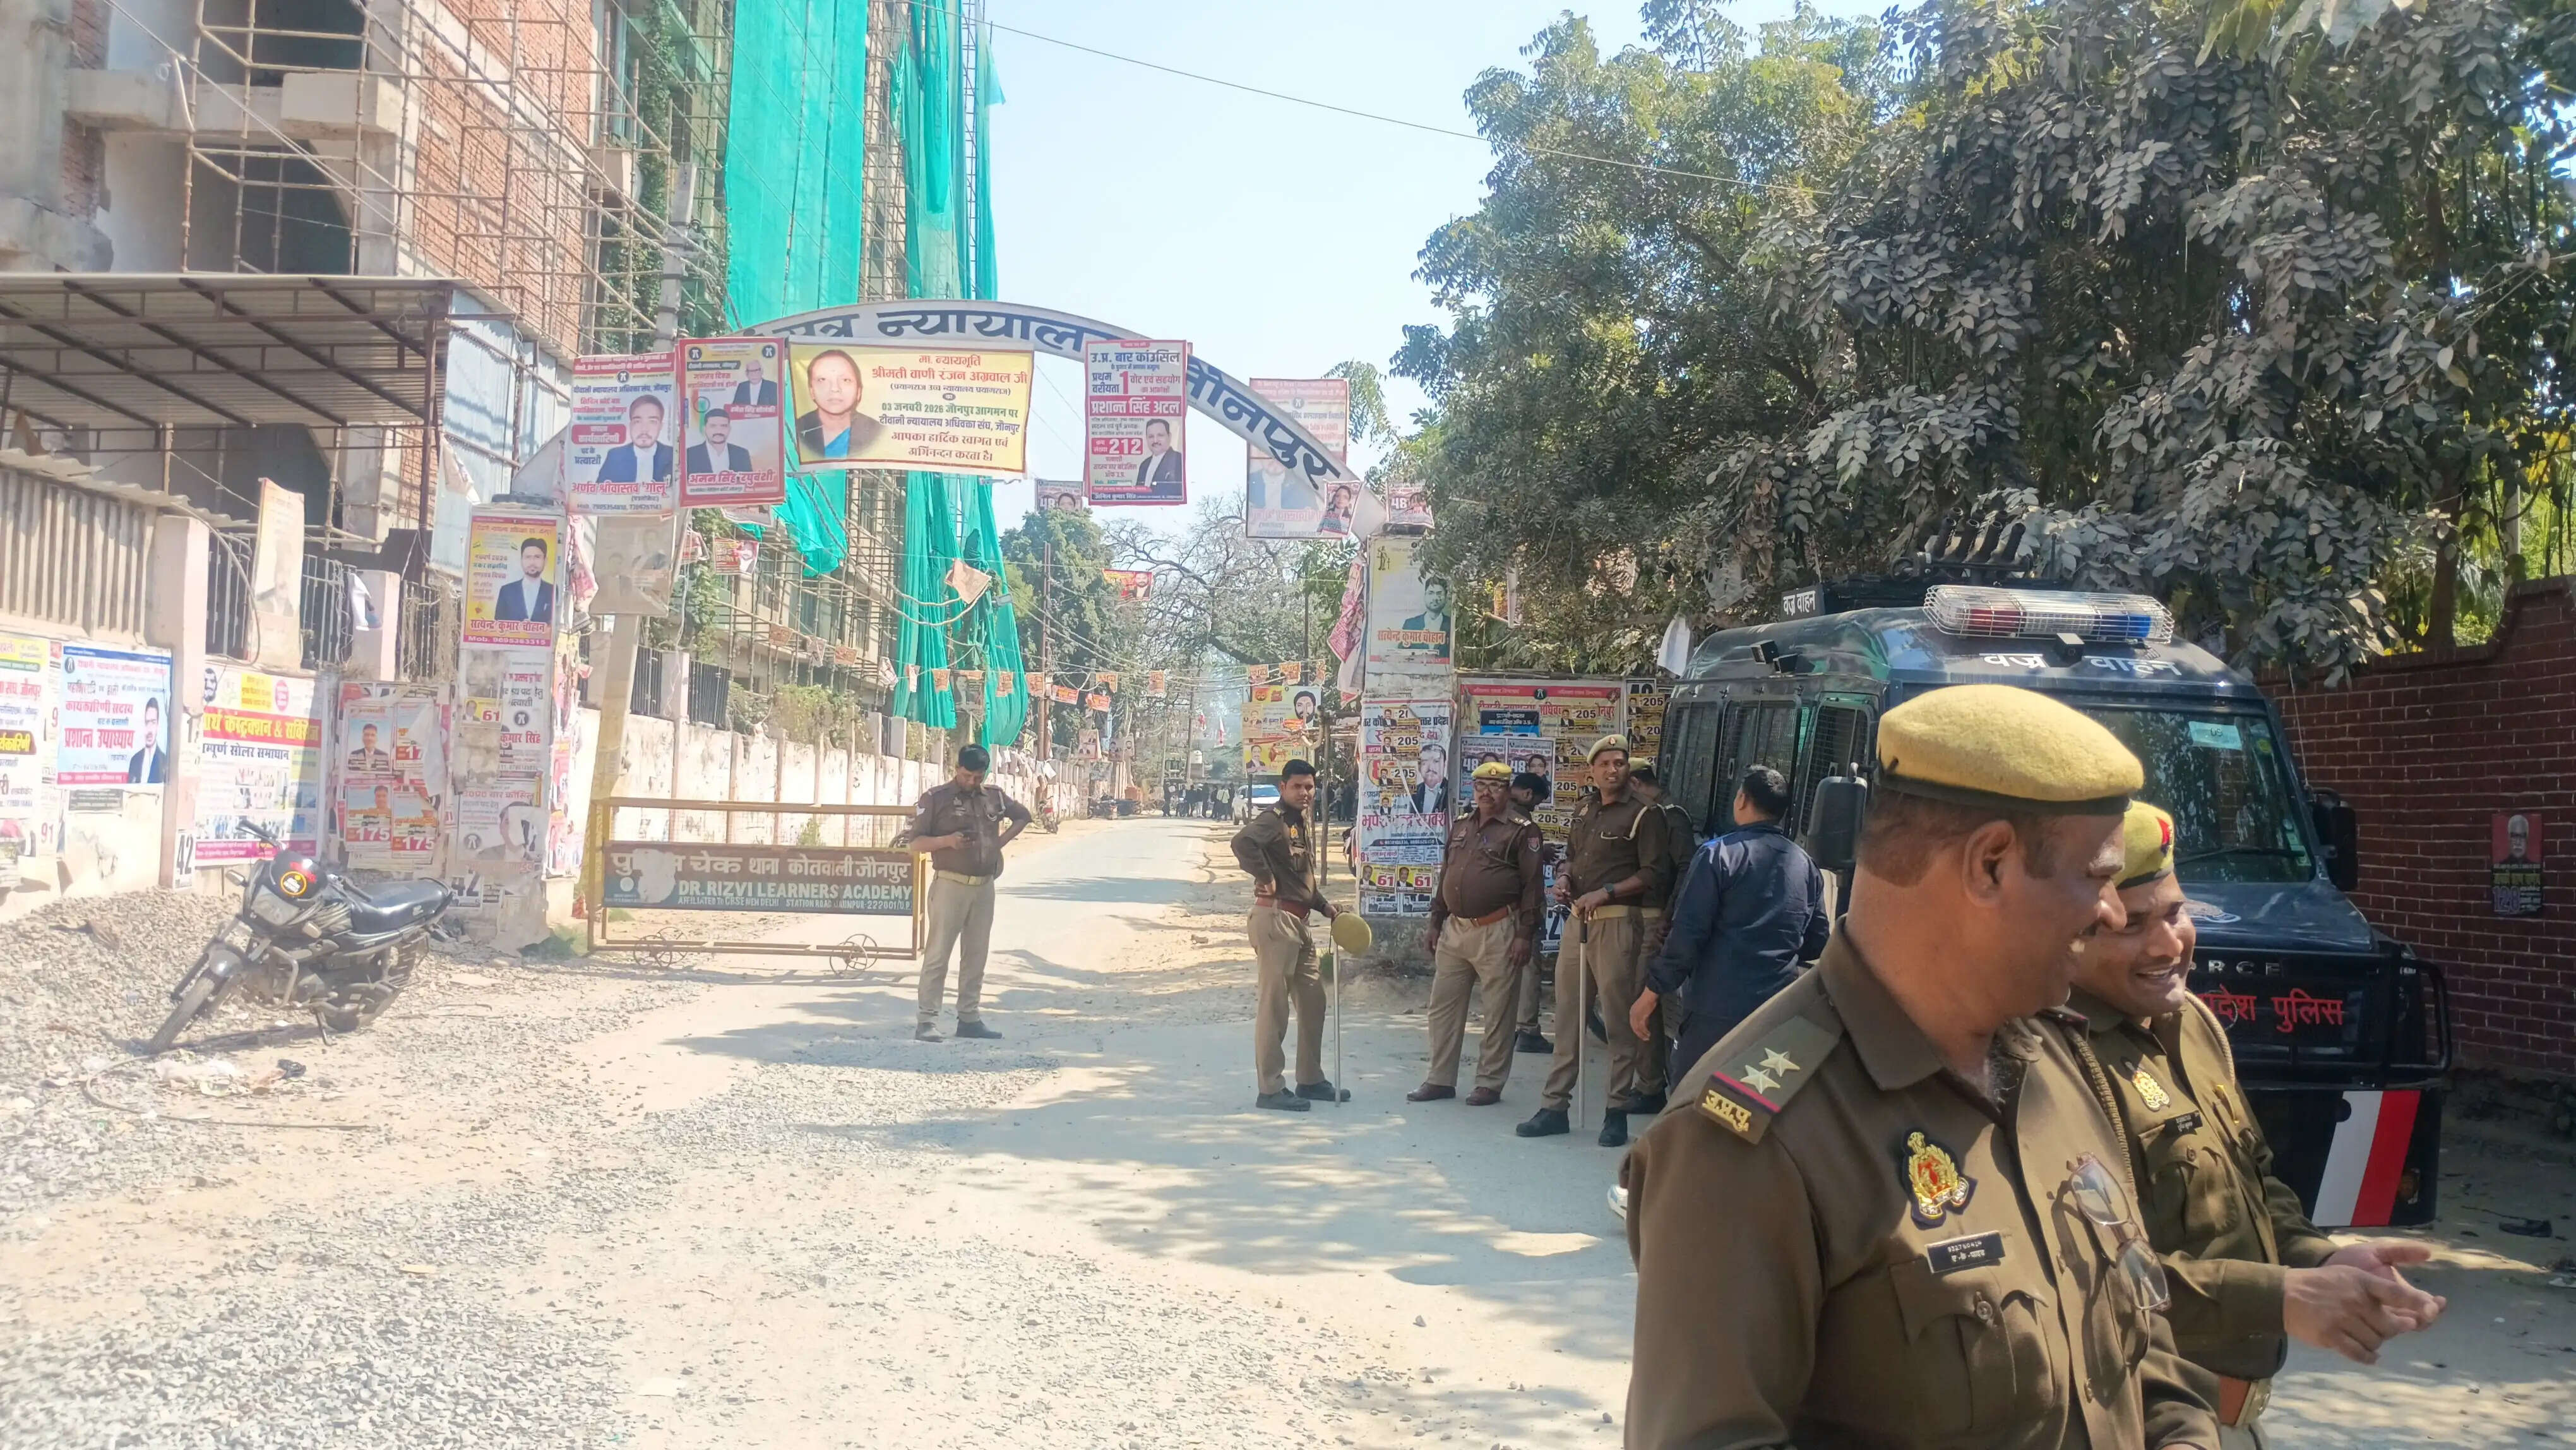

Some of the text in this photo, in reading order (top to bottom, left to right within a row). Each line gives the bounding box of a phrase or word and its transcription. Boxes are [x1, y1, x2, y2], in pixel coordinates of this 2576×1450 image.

[877, 309, 1121, 352] न्यायाल
[1115, 352, 1133, 362] बार
[872, 366, 1028, 384] श्रीमती वाणी रंजन अग्रवाल जी
[1092, 372, 1112, 381] प्रथम
[1119, 371, 1129, 394] 1
[1144, 374, 1154, 384] एवं
[1155, 373, 1181, 384] सहयोग
[1092, 382, 1119, 393] वरीयता
[881, 401, 1018, 418] 03 जनवरी 2026 जौनपुर आगमन पर
[1091, 397, 1181, 414] प्रशान्त सिंह अटल
[879, 414, 1020, 435] दीवानी न्यायालय अधिवक्ता संघ, जौनपुर
[891, 431, 1008, 448] आपका हार्दिक स्वागत एवं
[1109, 438, 1142, 454] 212
[575, 455, 601, 465] प्रत्याशी
[908, 446, 952, 458] अभिनन्दन
[955, 450, 981, 461] करता
[689, 473, 716, 484] अमन
[718, 470, 737, 484] सिंह
[600, 480, 640, 494] श्रीवास्तव
[1783, 589, 1816, 616] वज्र वाहन
[498, 620, 519, 633] कुमार
[523, 620, 546, 632] चौहान
[1402, 631, 1421, 646] कुमार
[1422, 629, 1445, 644] चौहान
[1979, 652, 2183, 676] वज्र वाहन
[112, 702, 134, 715] सदस्य
[1643, 697, 1664, 706] 205
[482, 710, 500, 722] 61
[1575, 710, 1596, 719] 205
[274, 720, 283, 738] &
[97, 728, 135, 749] उपाध्याय
[501, 730, 541, 748] कुमार सिंह
[1398, 736, 1419, 745] 205
[202, 741, 290, 760] म्पूर्ण सोलर समाधान
[1462, 758, 1479, 771] 48
[1510, 760, 1526, 773] 48
[1557, 782, 1577, 791] 205
[1537, 813, 1558, 824] 205
[356, 827, 391, 841] 175
[403, 836, 436, 850] 175
[177, 834, 194, 875] 42
[689, 850, 743, 873] चेक
[749, 857, 780, 875] थाना
[787, 853, 854, 877] कोतवाली
[855, 855, 912, 884] जौनपुर
[1377, 875, 1394, 886] 61
[1414, 875, 1431, 887] 61
[678, 880, 704, 896] DR.
[707, 880, 753, 897] RIZVI
[843, 885, 913, 900] ACADEMY
[677, 896, 716, 904] AFFILIATED
[725, 896, 745, 905] CBSE
[785, 899, 815, 908] STATION
[2270, 988, 2344, 1033] पुलिस
